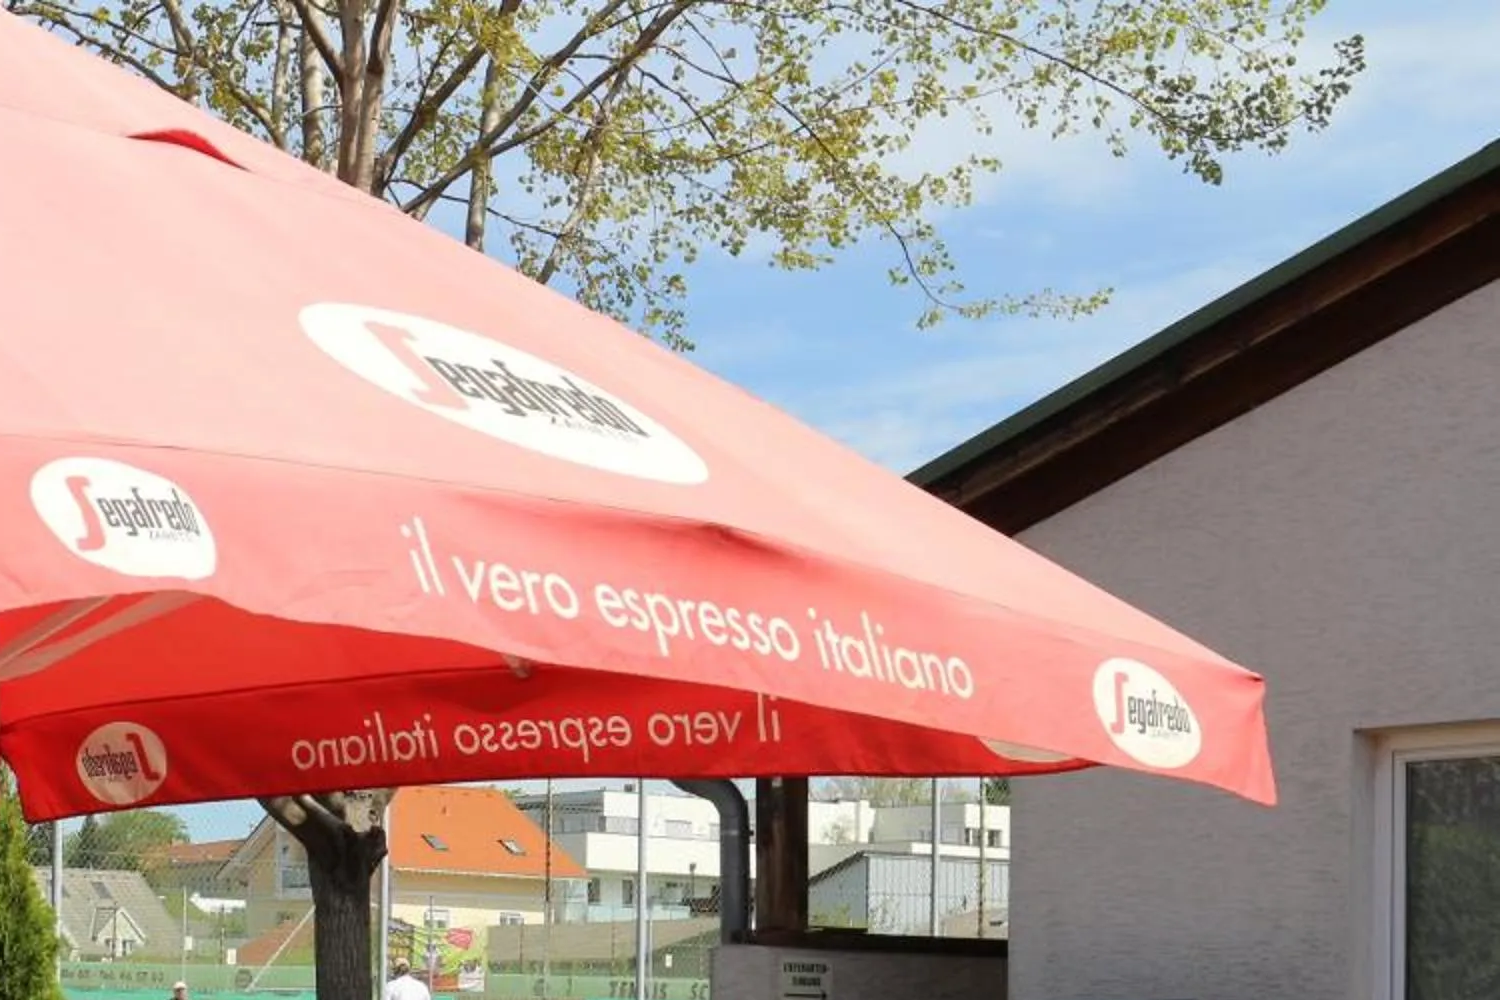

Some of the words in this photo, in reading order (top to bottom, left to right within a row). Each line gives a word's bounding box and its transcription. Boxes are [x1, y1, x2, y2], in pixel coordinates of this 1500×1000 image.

[363, 320, 650, 438] Segafredo
[65, 475, 200, 551] Segafredo
[401, 516, 445, 596] il
[452, 555, 580, 619] vero
[595, 583, 800, 661] espresso
[807, 607, 974, 699] italiano
[1109, 671, 1191, 735] Segafredo
[690, 982, 709, 1000] SC
